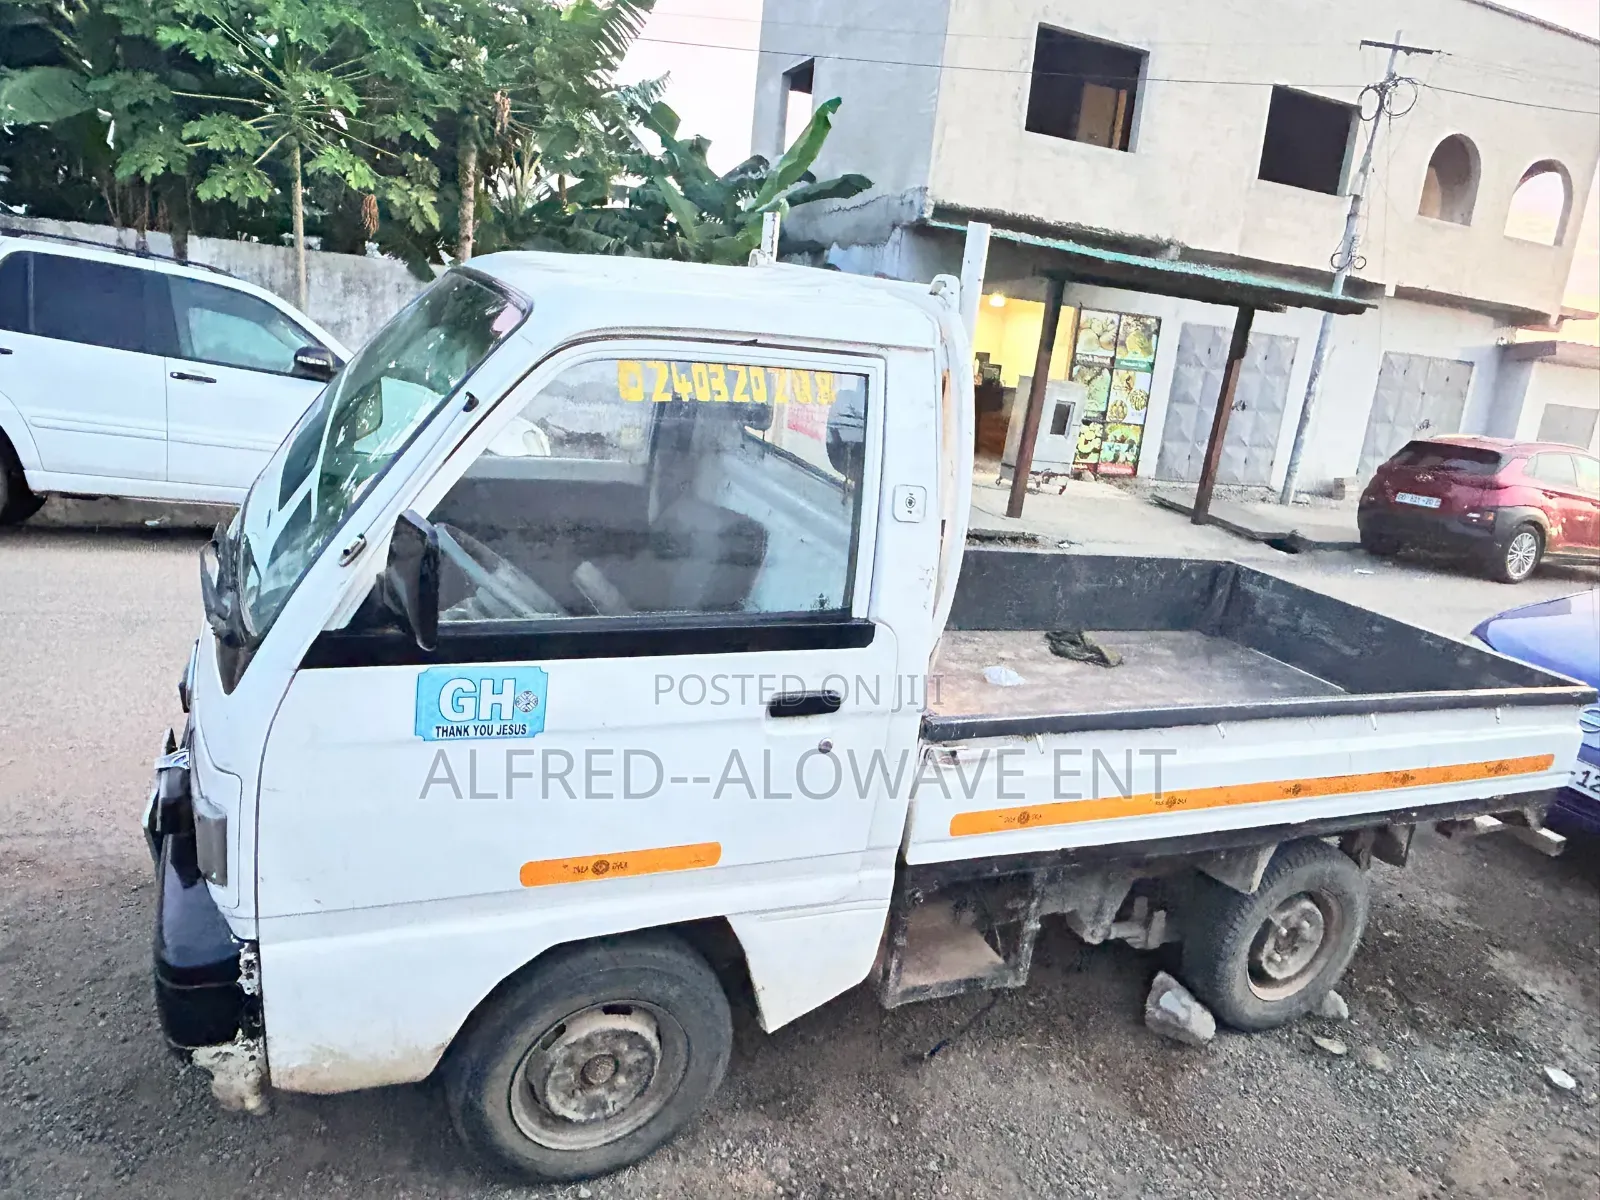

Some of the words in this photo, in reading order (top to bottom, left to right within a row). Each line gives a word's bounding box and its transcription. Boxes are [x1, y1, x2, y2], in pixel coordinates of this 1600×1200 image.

[438, 677, 516, 722] GH
[435, 725, 469, 738] THANK
[473, 724, 494, 736] YOU
[496, 723, 527, 736] JESUS
